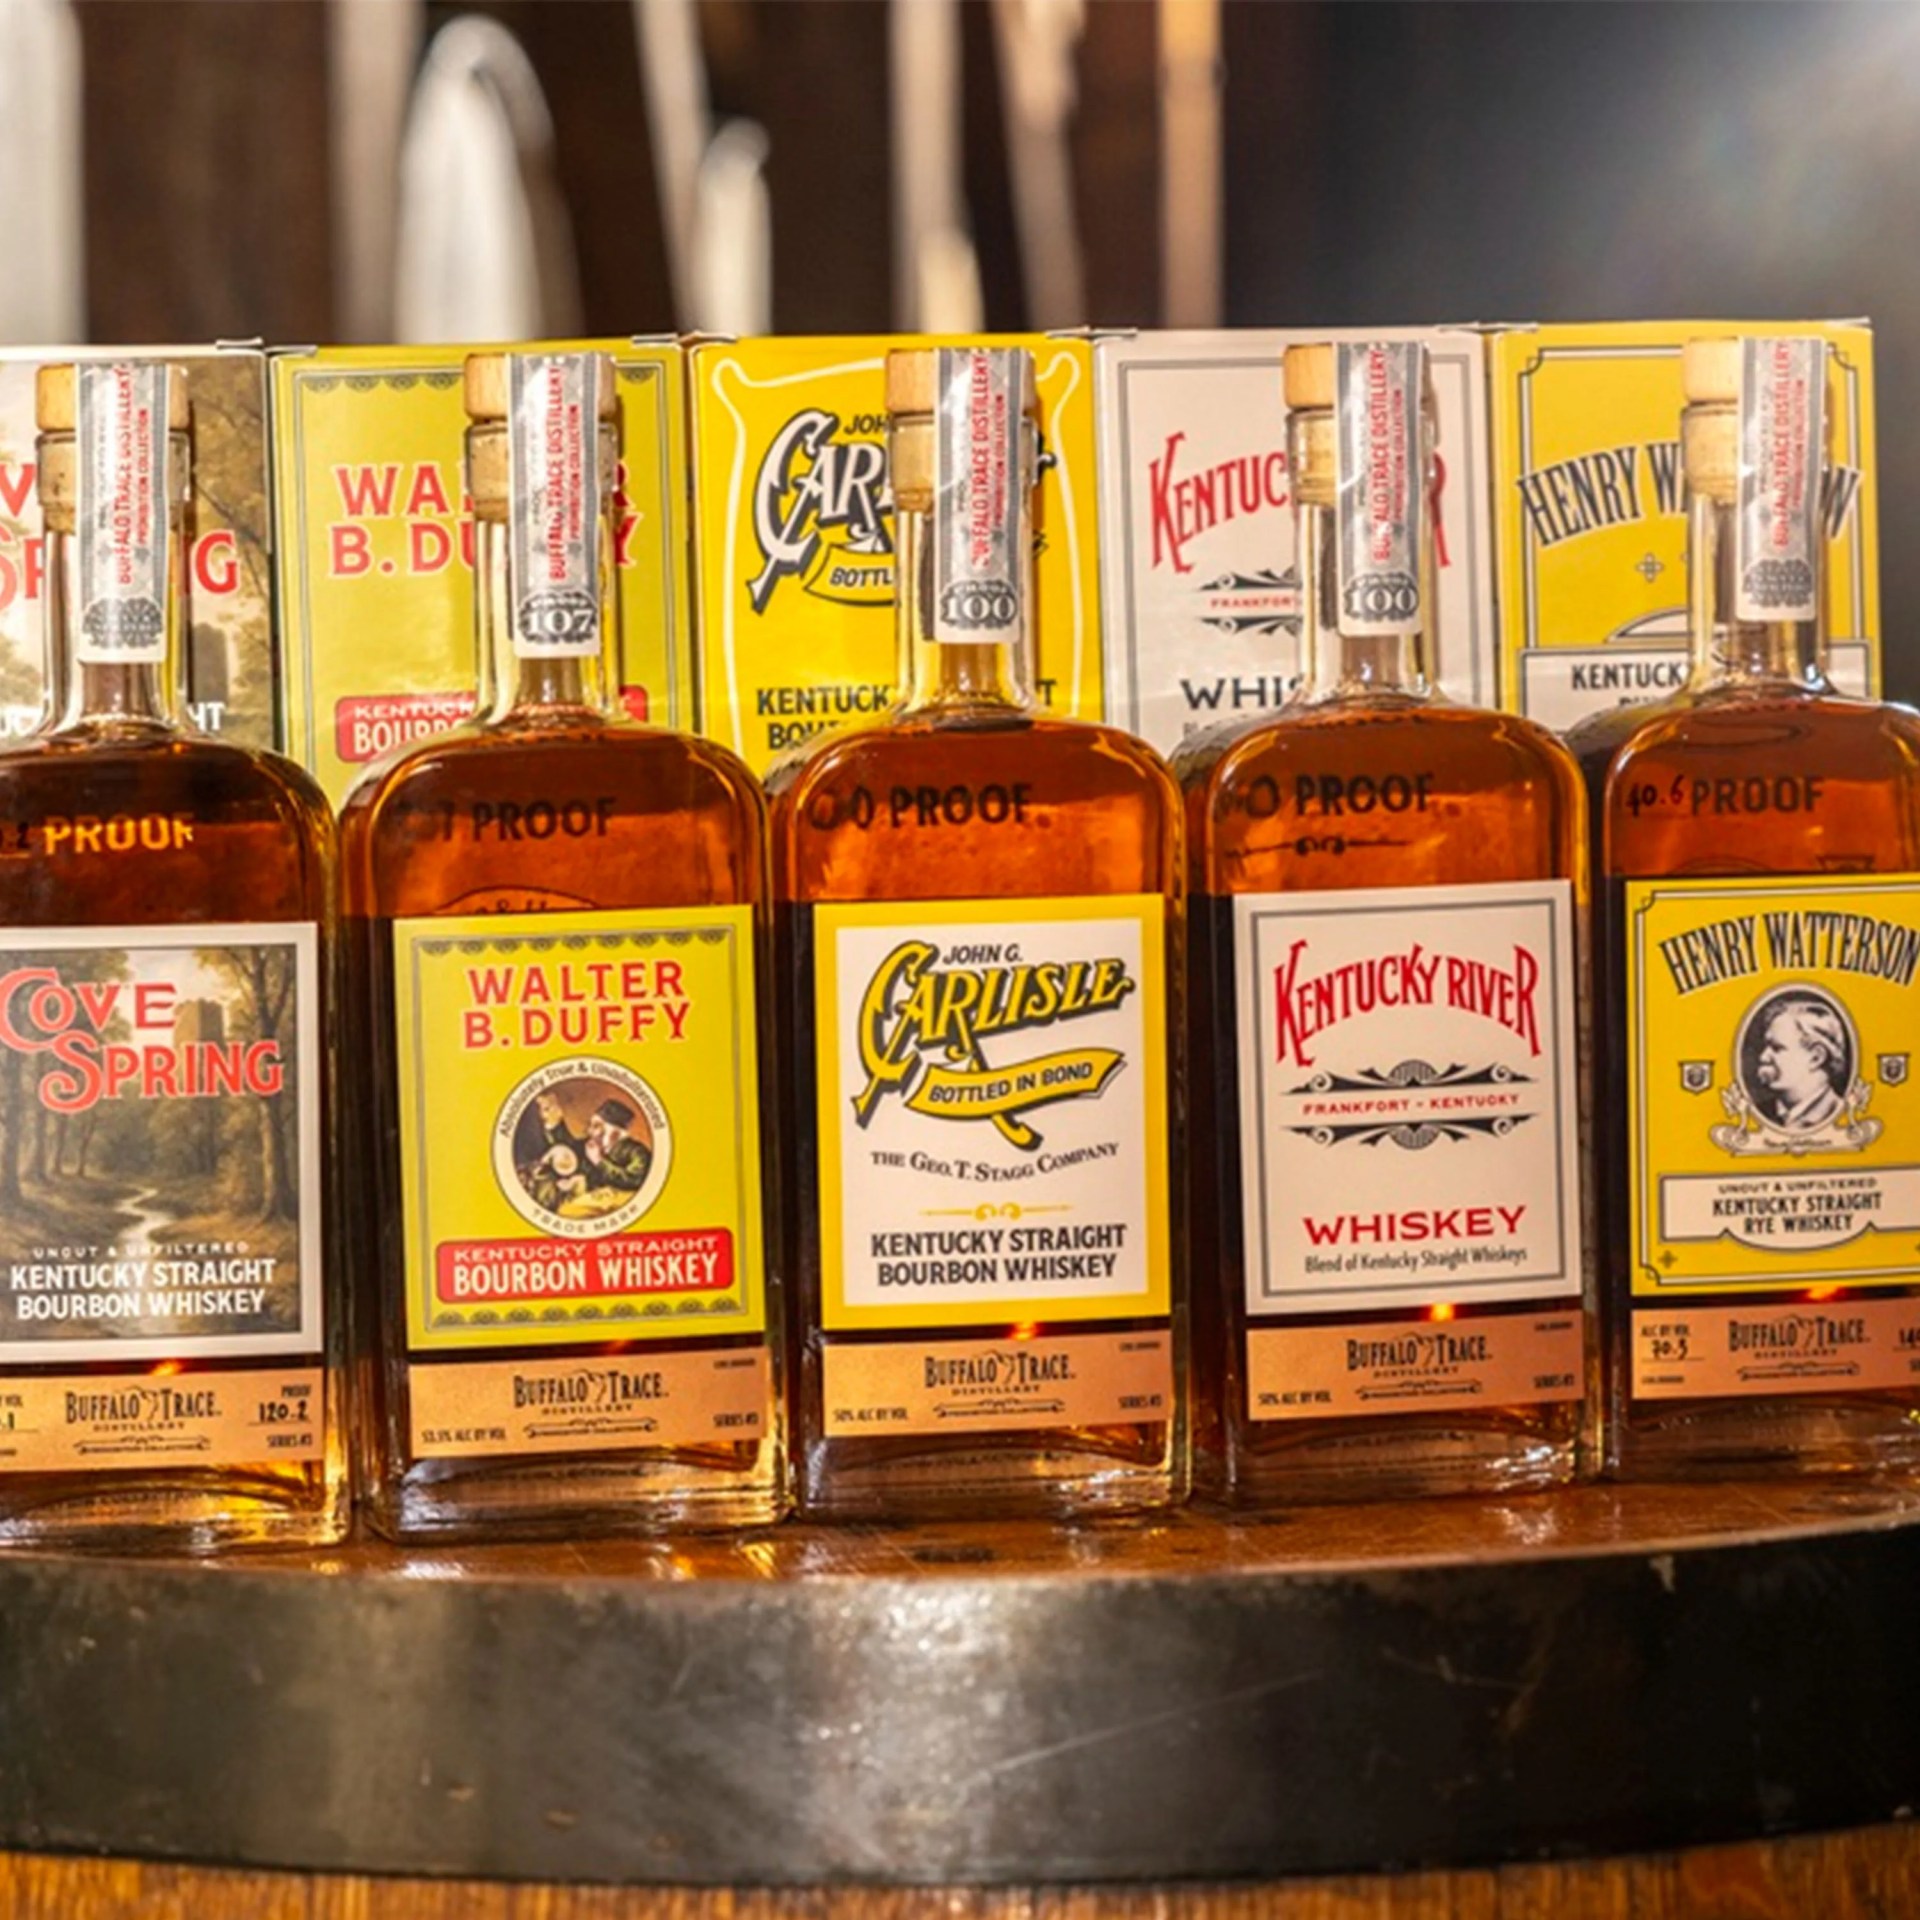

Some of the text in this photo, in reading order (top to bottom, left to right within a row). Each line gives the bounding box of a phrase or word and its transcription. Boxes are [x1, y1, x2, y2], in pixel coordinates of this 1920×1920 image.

[972, 356, 990, 443] DISTILLERY
[1370, 350, 1388, 436] DISTILLERY
[1774, 340, 1789, 428] DISTILLERY
[845, 412, 897, 435] JOH
[972, 449, 990, 495] TRACE
[1371, 442, 1389, 488] TRACE
[1774, 434, 1789, 478] TRACE
[113, 466, 132, 511] TRACE
[547, 460, 564, 507] TRACE
[1514, 445, 1639, 546] HENRY
[1149, 432, 1289, 573] KENTUC
[829, 565, 894, 587] BOTTL
[946, 592, 1016, 624] 100
[1351, 586, 1416, 614] 100
[528, 608, 594, 636] 107
[1572, 661, 1683, 690] KENTUCK
[354, 698, 475, 720] KENTUCK
[756, 684, 890, 716] KENTUCK
[889, 782, 1032, 830] PROOF
[1296, 771, 1435, 817] PROOF
[1691, 775, 1823, 816] PROOF
[472, 797, 616, 842] PROOF
[942, 943, 1024, 965] JOHN G.
[1658, 910, 1920, 996] HENRY WATTERSON
[466, 960, 685, 1006] WALTER
[0, 967, 177, 1053] COVE
[1273, 939, 1542, 1068] KENTUCKY RIVER
[853, 939, 1136, 1115] CARLISLE
[39, 1029, 282, 1114] SPRING
[928, 1061, 1094, 1105] BOTTLED IN BOND
[1302, 1098, 1411, 1117] FRANKFORT
[1429, 1094, 1521, 1111] KENTUCKY
[870, 1150, 906, 1169] THE
[974, 1160, 1036, 1183] STAGG
[1036, 1141, 1121, 1174] COMPANY
[1718, 1182, 1769, 1195] UNCUT
[1787, 1177, 1878, 1193] UNFILTERED
[532, 1204, 638, 1234] TRADE MARK
[1712, 1192, 1883, 1217] KENTUCKY STRAIGHT
[870, 1223, 1128, 1258] KENTUCKY STRAIGHT
[1302, 1204, 1527, 1247] WHISKEY
[1744, 1213, 1854, 1235] RYE WHISKEY
[33, 1246, 98, 1259] UNCUT
[127, 1241, 250, 1258] UNFILTERED
[453, 1236, 720, 1262] KENTUCKY STRAIGHT
[1304, 1245, 1528, 1274] Blend of Kentucky Straight Whiskeys
[10, 1258, 277, 1292] KENTUCKY STRAIGHT
[453, 1252, 720, 1297] BOURBON WHISKEY
[877, 1253, 1118, 1288] BOURBON WHISKEY
[17, 1288, 266, 1320] BOURBON WHISKEY
[1728, 1320, 1796, 1352] BUFFALO
[1346, 1338, 1418, 1371] BUFFALO
[924, 1356, 998, 1389] BUFFALO
[65, 1390, 140, 1425] BUFFALO
[513, 1373, 587, 1408] BUFFALO
